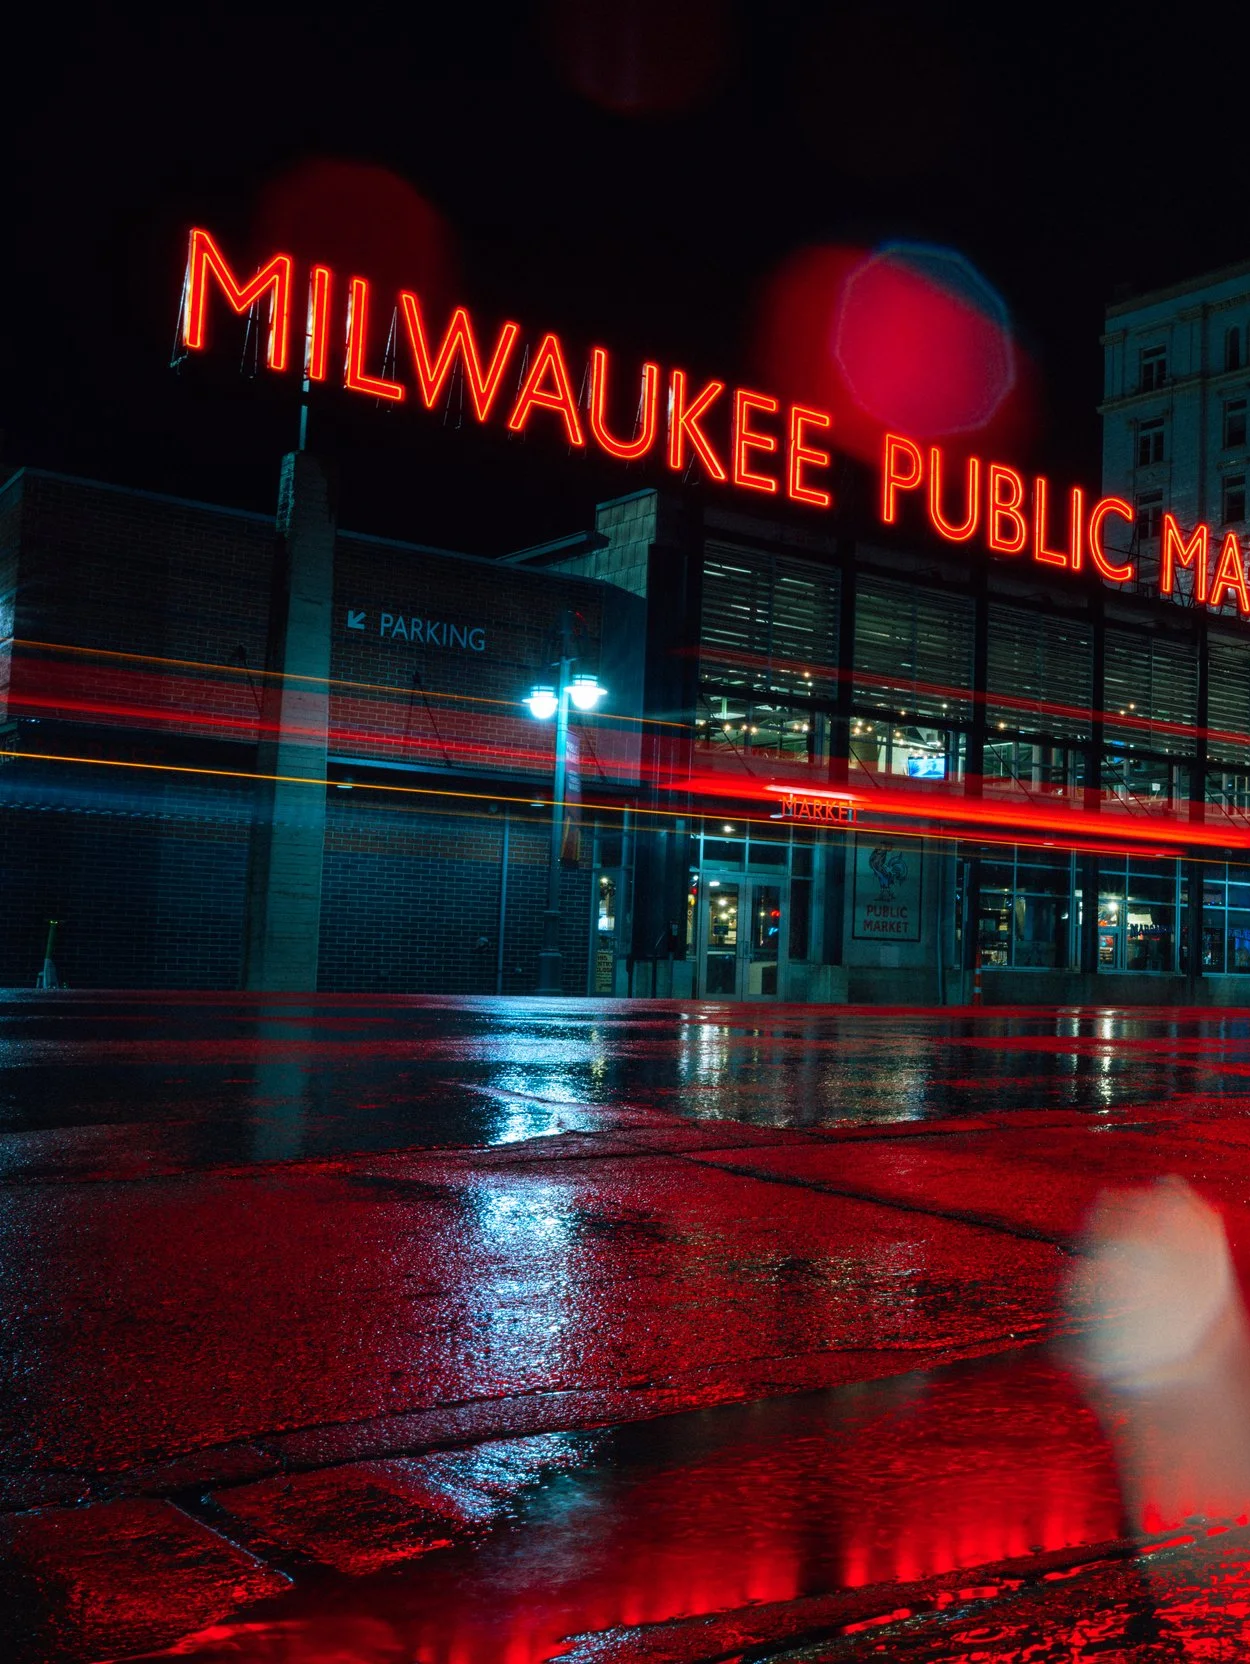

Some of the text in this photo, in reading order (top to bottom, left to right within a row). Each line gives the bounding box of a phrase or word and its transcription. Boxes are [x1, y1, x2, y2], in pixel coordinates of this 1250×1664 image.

[184, 228, 831, 507] MILWAUKEE
[883, 433, 1134, 582] PUBLIC
[380, 612, 485, 651] PARKING
[781, 796, 858, 824] MARKET
[866, 904, 908, 918] PUBLIC
[863, 920, 909, 933] MARKET
